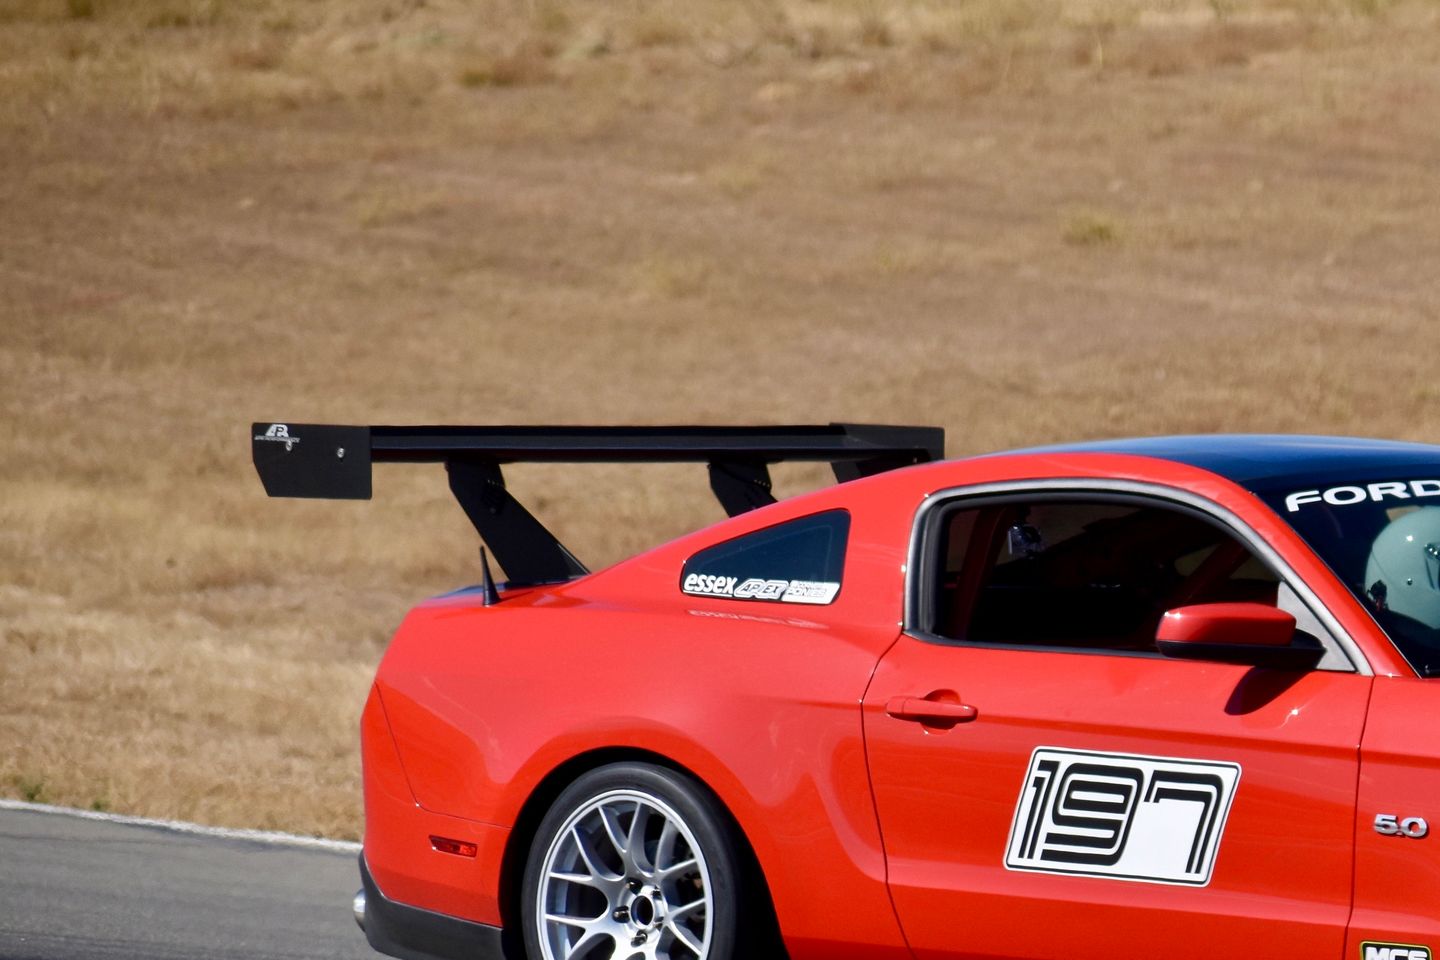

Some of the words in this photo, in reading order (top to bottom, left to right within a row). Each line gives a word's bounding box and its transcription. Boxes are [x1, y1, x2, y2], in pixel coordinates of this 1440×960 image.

[684, 573, 738, 594] essex
[1018, 759, 1223, 874] 197
[1374, 813, 1428, 838] 5.0
